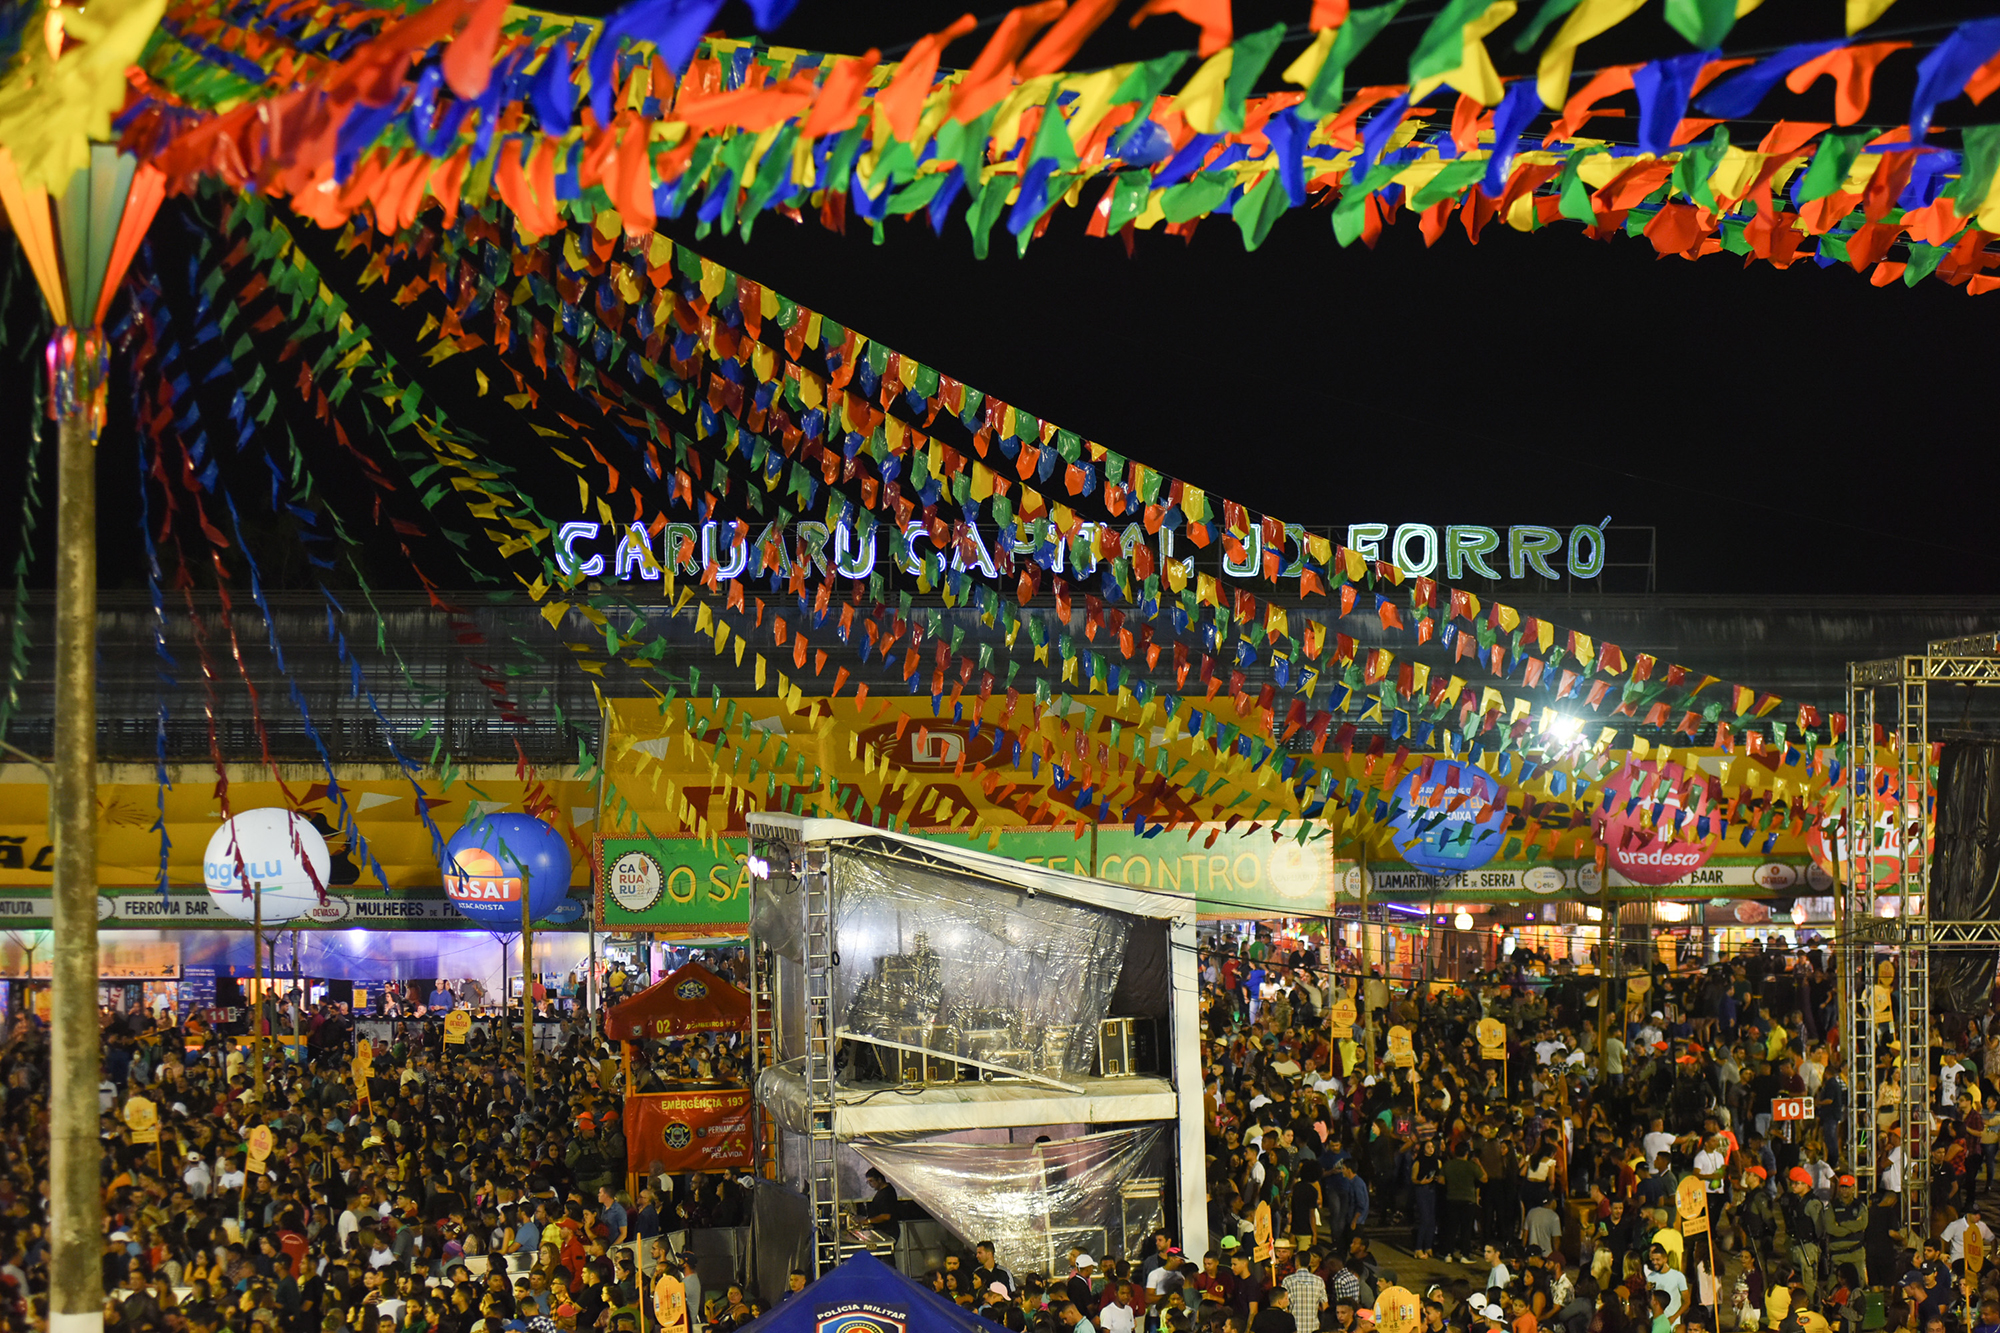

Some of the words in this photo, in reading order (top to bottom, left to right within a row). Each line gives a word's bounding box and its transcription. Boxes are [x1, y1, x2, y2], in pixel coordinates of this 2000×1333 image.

[555, 520, 876, 580] CARUARU
[902, 519, 1194, 580] CAPITAL
[1348, 515, 1612, 580] FORRÓ
[1618, 850, 1700, 866] bradesco
[619, 864, 636, 873] CA
[619, 874, 645, 884] RUA
[667, 865, 697, 903] O
[1480, 874, 1516, 887] SERRA
[1691, 871, 1724, 884] BAAR
[1762, 876, 1788, 885] DEVASSA
[619, 885, 636, 894] RU
[125, 901, 180, 915] FERROVIA
[185, 901, 208, 915] BAR
[313, 908, 339, 917] DEVASSA
[356, 902, 424, 916] MULHERES
[458, 903, 505, 911] ATACADISTA
[210, 1010, 225, 1021] 11
[656, 1019, 671, 1034] 02
[661, 1096, 723, 1110] EMERGÊNCIA
[727, 1096, 744, 1107] 193
[1778, 1102, 1800, 1117] 10
[708, 1124, 746, 1133] PERNAMBUCO
[817, 1304, 860, 1320] POLÍCIA
[863, 1304, 907, 1320] MILITAR
